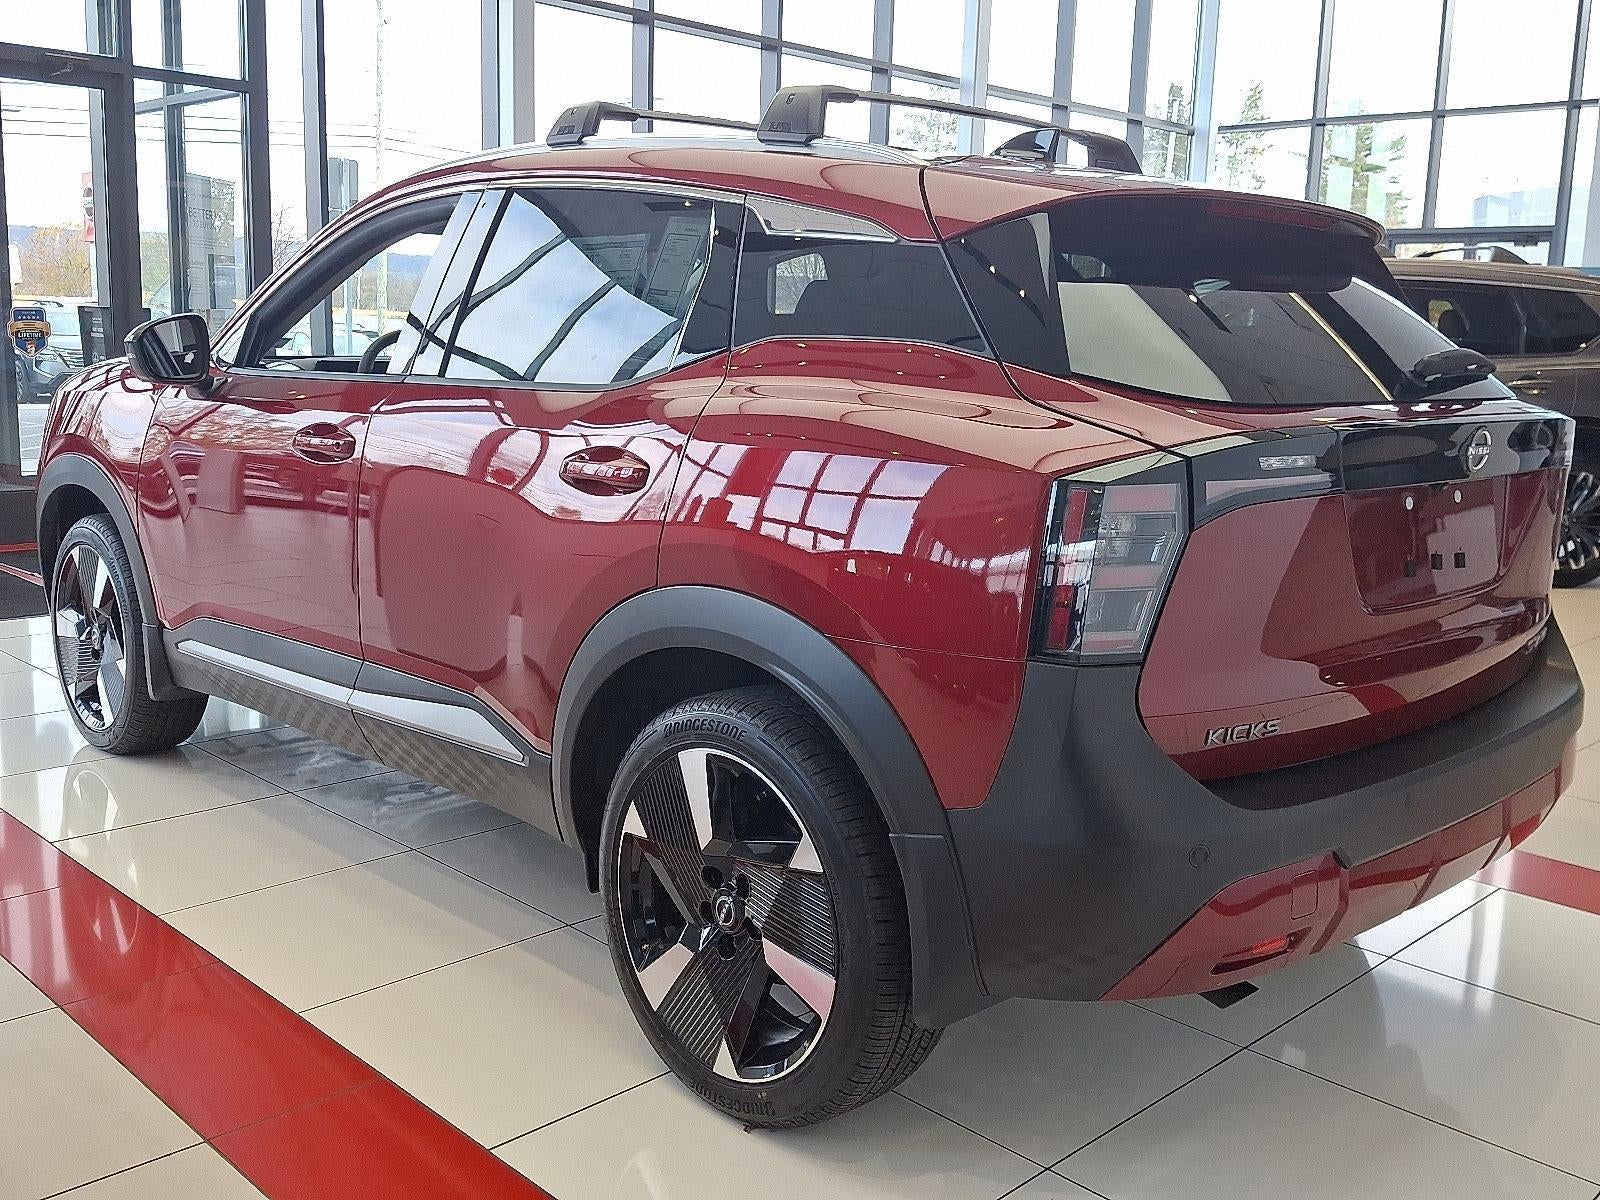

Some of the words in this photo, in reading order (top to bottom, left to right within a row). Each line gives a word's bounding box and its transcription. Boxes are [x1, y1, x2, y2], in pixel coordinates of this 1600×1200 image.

[1467, 446, 1490, 455] NISS
[663, 718, 747, 740] BRIDGESTONE
[1204, 718, 1281, 746] KICKS
